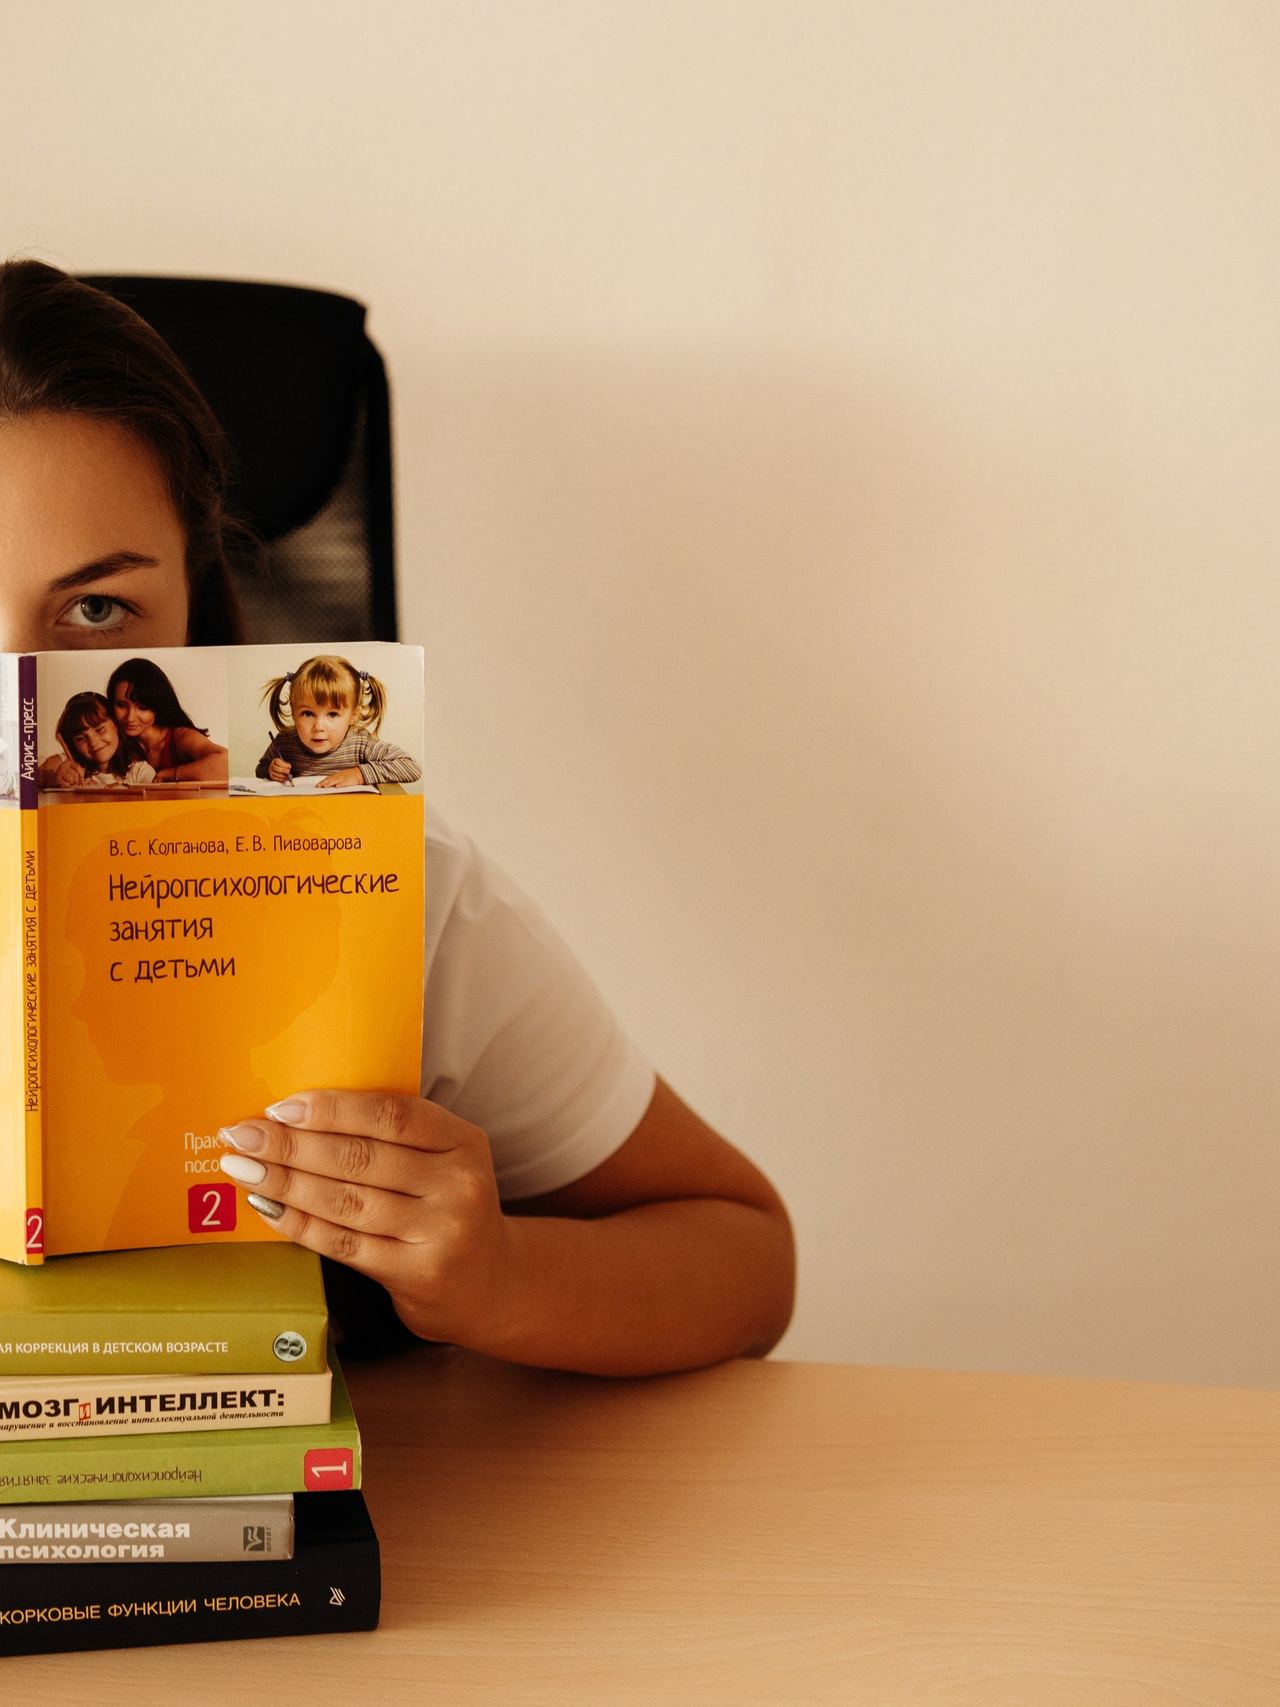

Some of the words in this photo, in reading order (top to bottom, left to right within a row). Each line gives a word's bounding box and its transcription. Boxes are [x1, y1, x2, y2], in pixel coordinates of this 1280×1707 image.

[21, 698, 37, 780] Айрис-пресс
[110, 840, 123, 856] В.
[127, 840, 141, 855] С.
[149, 838, 229, 857] Колганова,
[236, 837, 248, 852] Е.
[252, 836, 266, 851] В.
[273, 835, 361, 855] Пивоварова
[26, 851, 37, 900] детьми
[109, 873, 399, 908] Нейропсихологические
[26, 917, 37, 967] занятия
[110, 917, 213, 942] занятия
[110, 961, 123, 982] с
[135, 957, 236, 983] детьми
[25, 972, 41, 1112] Нейропсихологические
[201, 1190, 221, 1226] 2
[27, 1215, 42, 1248] 2
[15, 1342, 89, 1355] КОРРЕКЦИЯ
[92, 1342, 100, 1353] В
[102, 1342, 163, 1355] ДЕТСКОМ
[166, 1341, 228, 1353] ВОЗРАСТЕ
[96, 1389, 284, 1415] ИНТЕЛЛЕКТ:
[57, 1418, 129, 1429] восстановление
[131, 1412, 217, 1425] интеллектуальной
[219, 1410, 284, 1420] деятельности
[56, 1467, 202, 1485] Нейропсихологические
[311, 1460, 347, 1478] 1
[0, 1605, 101, 1625] КОРКОВЫЕ
[107, 1599, 197, 1618] ФУНКЦИИ
[204, 1592, 301, 1612] ЧЕЛОВЕКА
